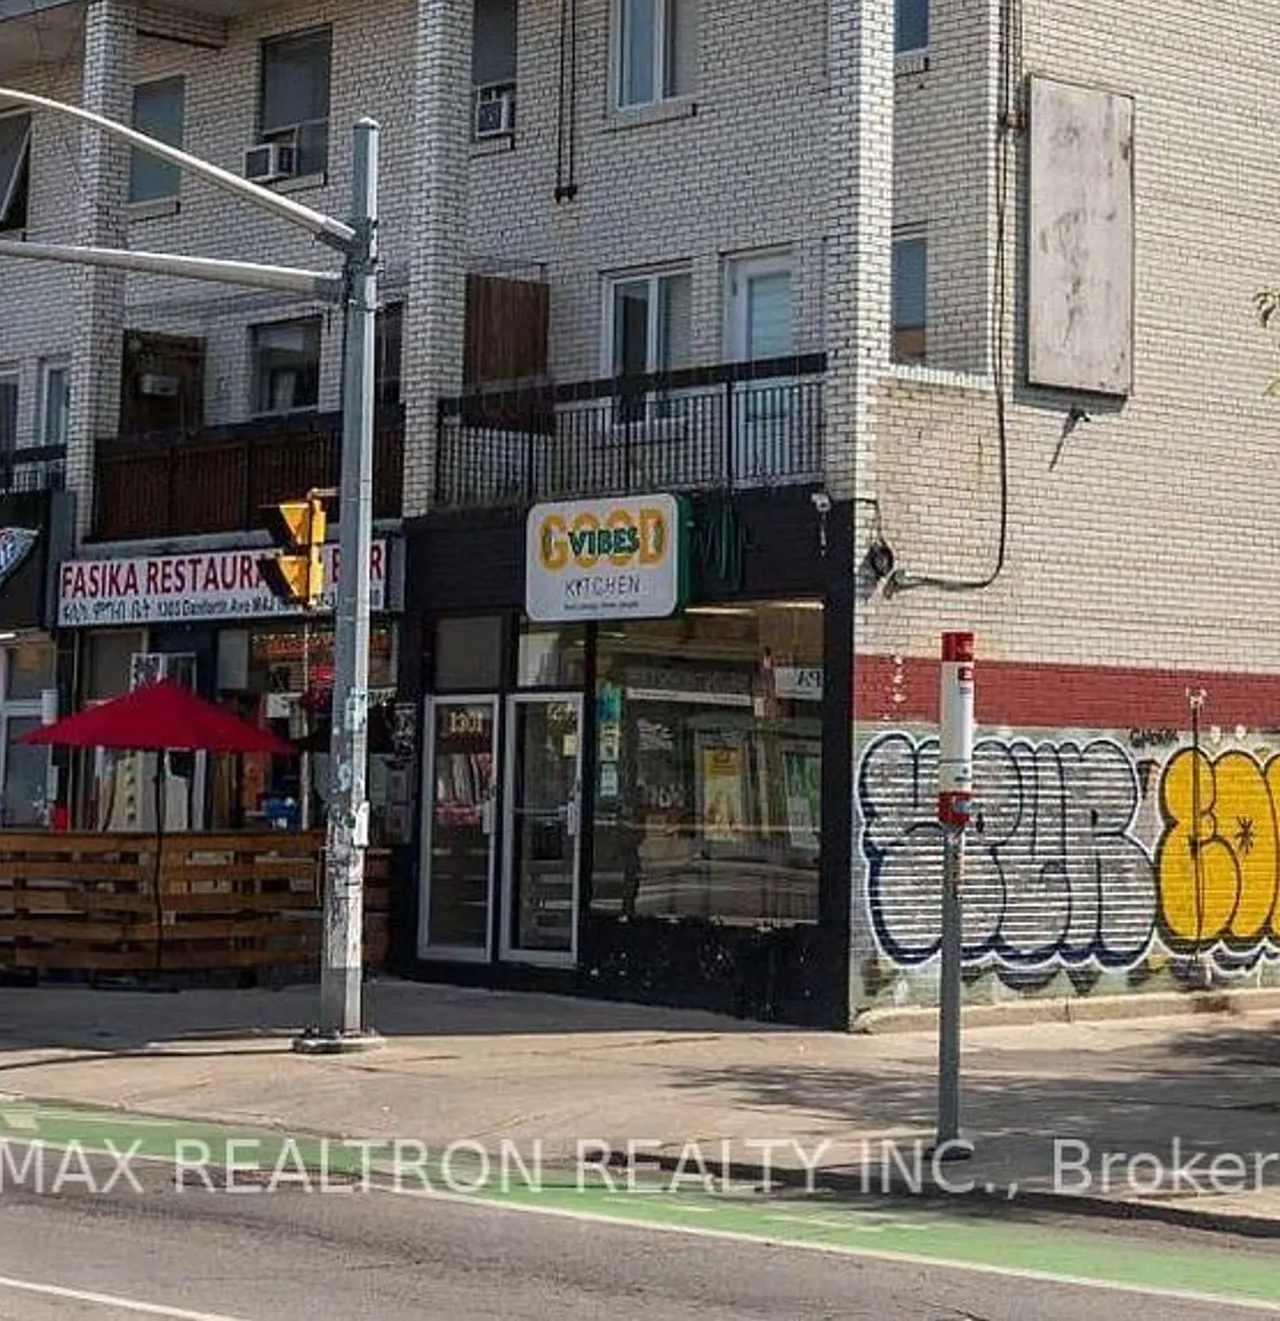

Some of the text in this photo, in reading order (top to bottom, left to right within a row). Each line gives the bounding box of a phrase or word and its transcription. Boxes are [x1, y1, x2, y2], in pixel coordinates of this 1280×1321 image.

[540, 509, 665, 571] GOOD
[568, 526, 640, 555] VIBES
[62, 562, 138, 599] FASIKA
[147, 554, 267, 595] RESTAUR
[565, 576, 640, 596] KITCHEN
